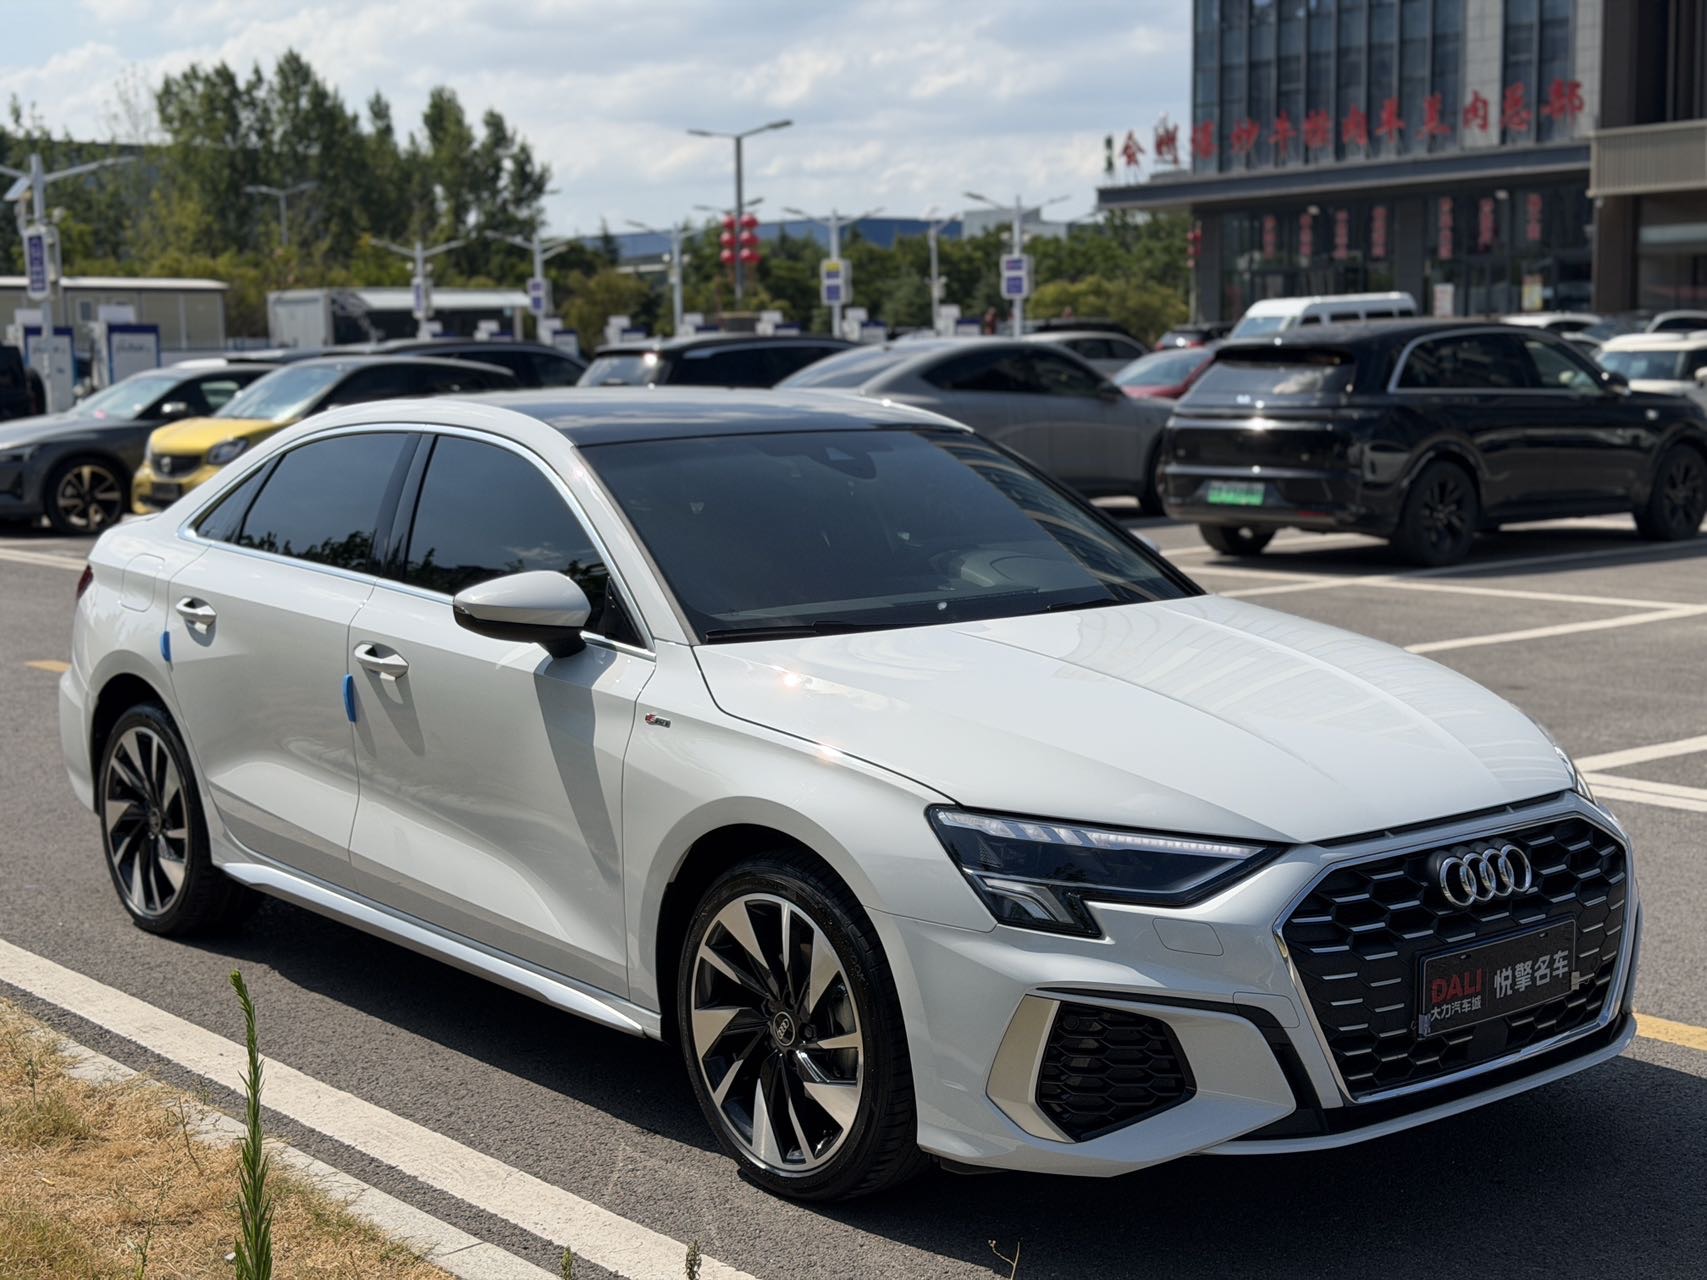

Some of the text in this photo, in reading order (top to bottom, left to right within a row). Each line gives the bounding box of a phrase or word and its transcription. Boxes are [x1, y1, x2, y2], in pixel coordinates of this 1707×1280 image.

[1431, 968, 1485, 1004] DALI
[1493, 949, 1569, 999] 悦擎名车
[1430, 994, 1482, 1022] 大力汽车城
